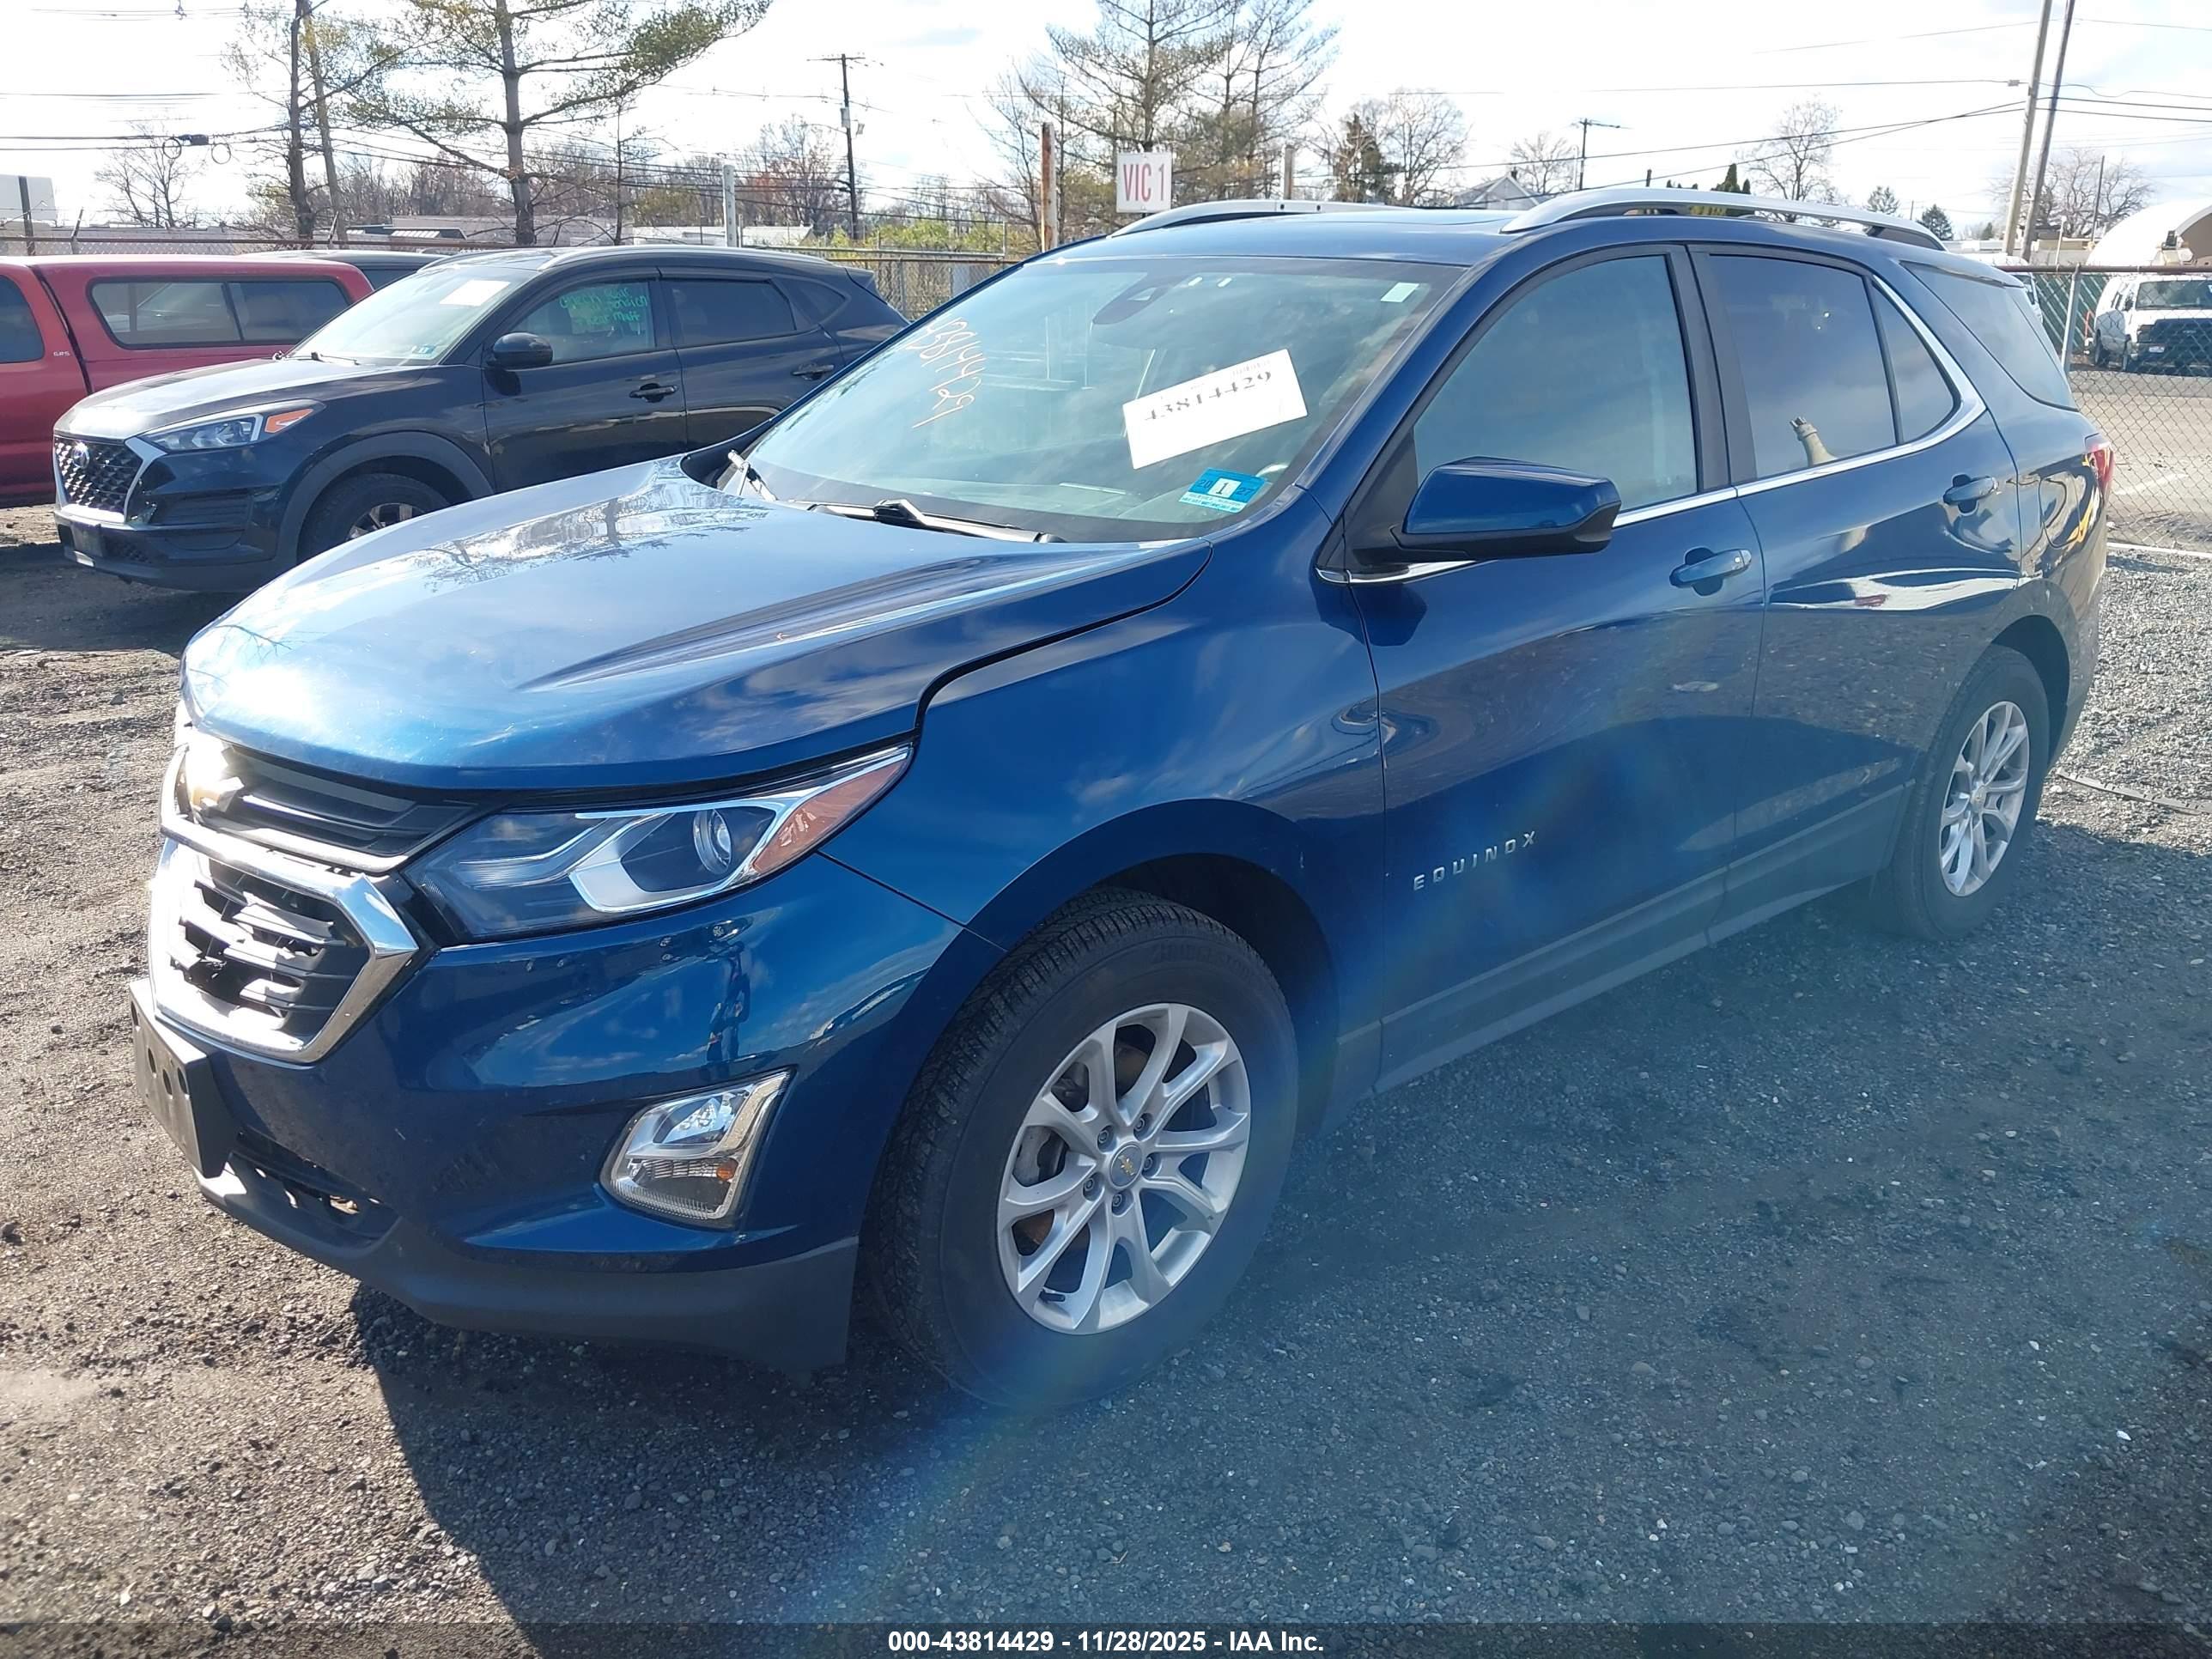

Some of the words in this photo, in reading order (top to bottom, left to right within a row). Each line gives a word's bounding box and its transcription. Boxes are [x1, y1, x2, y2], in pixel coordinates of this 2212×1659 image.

[1123, 163, 1152, 202] VIC
[1158, 163, 1165, 201] 1
[1144, 370, 1273, 422] 43814429
[1215, 482, 1228, 495] 1
[1413, 830, 1535, 891] EQUINOX
